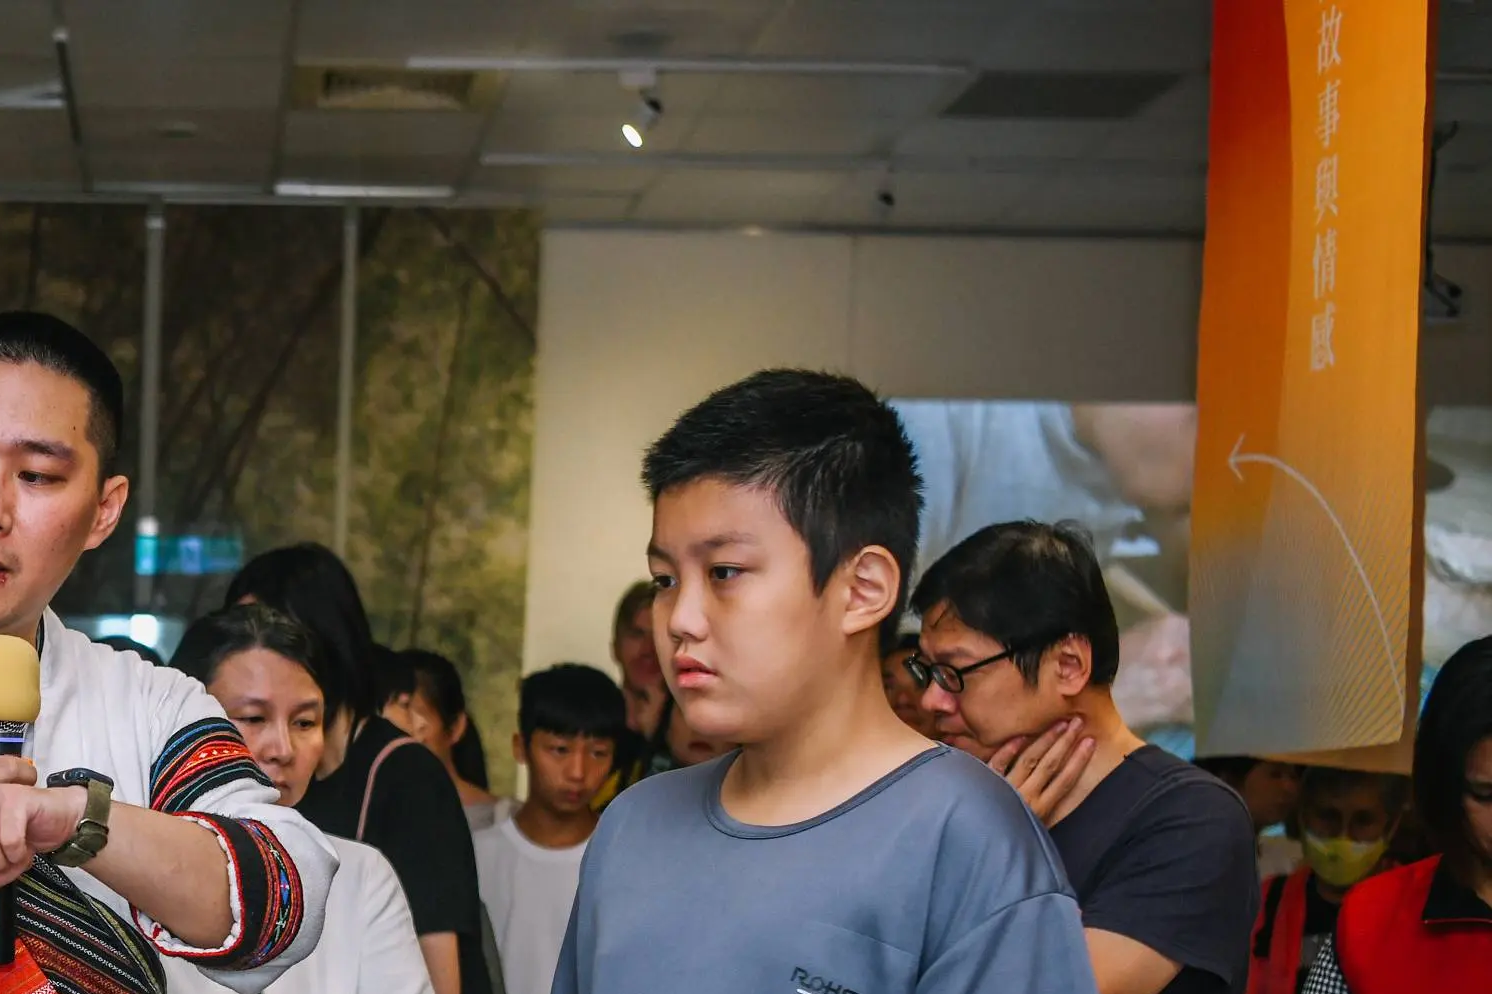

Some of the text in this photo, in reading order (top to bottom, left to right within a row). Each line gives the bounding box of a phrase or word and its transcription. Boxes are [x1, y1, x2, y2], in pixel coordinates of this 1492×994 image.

[1311, 4, 1343, 371] 故事與情感
